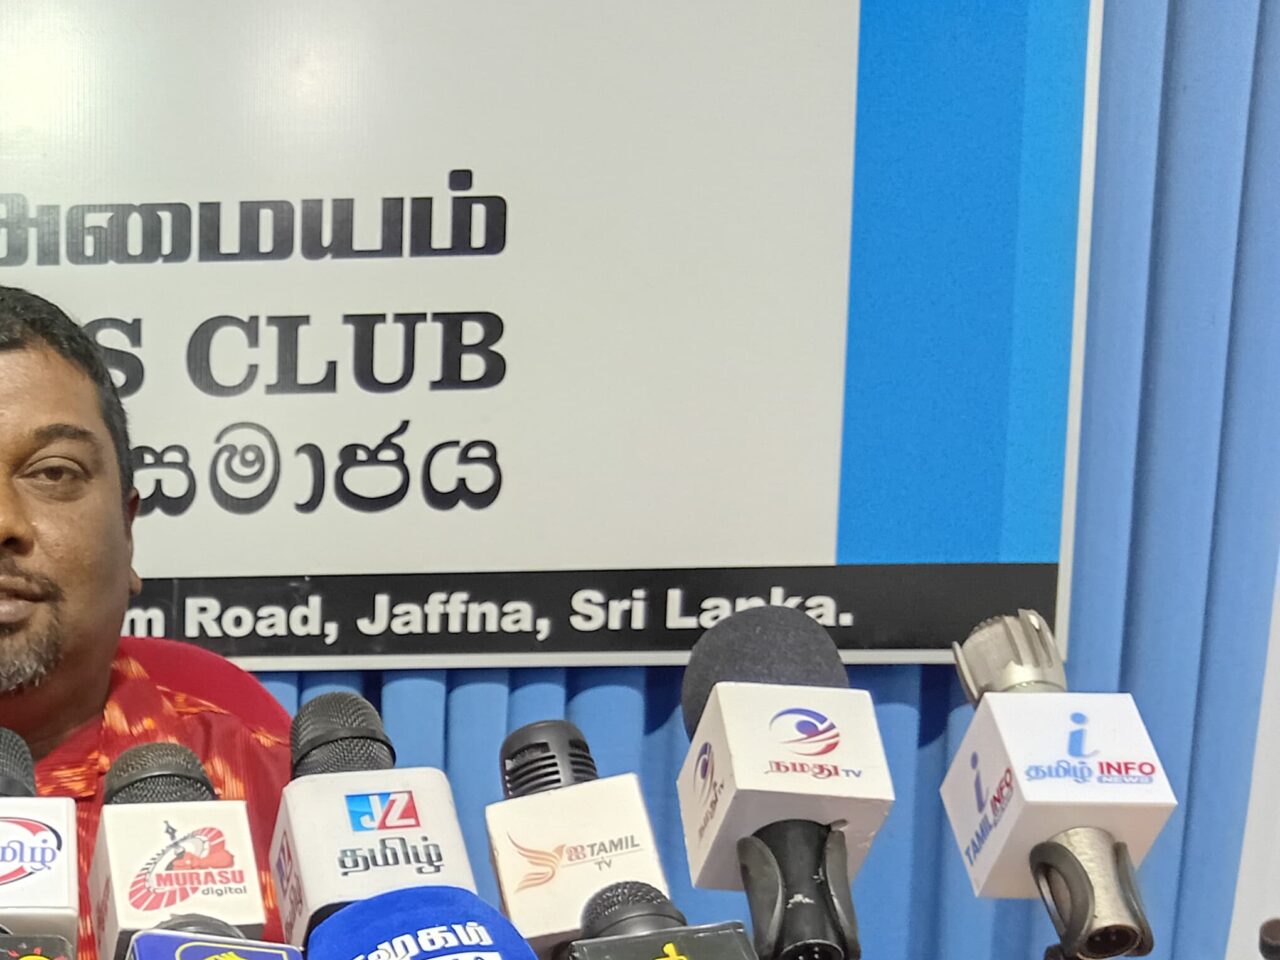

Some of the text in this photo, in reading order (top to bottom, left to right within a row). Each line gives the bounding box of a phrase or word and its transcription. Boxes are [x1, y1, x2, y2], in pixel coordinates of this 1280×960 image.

[186, 311, 507, 397] CLUB
[184, 595, 340, 645] Road,
[356, 591, 551, 642] Jaffna,
[570, 589, 647, 631] Sri
[764, 760, 863, 779] நமது TV
[1025, 759, 1157, 784] தமிழ் INFO
[357, 793, 419, 830] JZ
[965, 813, 993, 866] TAMIL
[990, 767, 1013, 817] INFO
[338, 836, 444, 876] தமிழ்
[594, 858, 612, 871] TV
[155, 870, 245, 887] MURASU
[201, 885, 248, 897] digital
